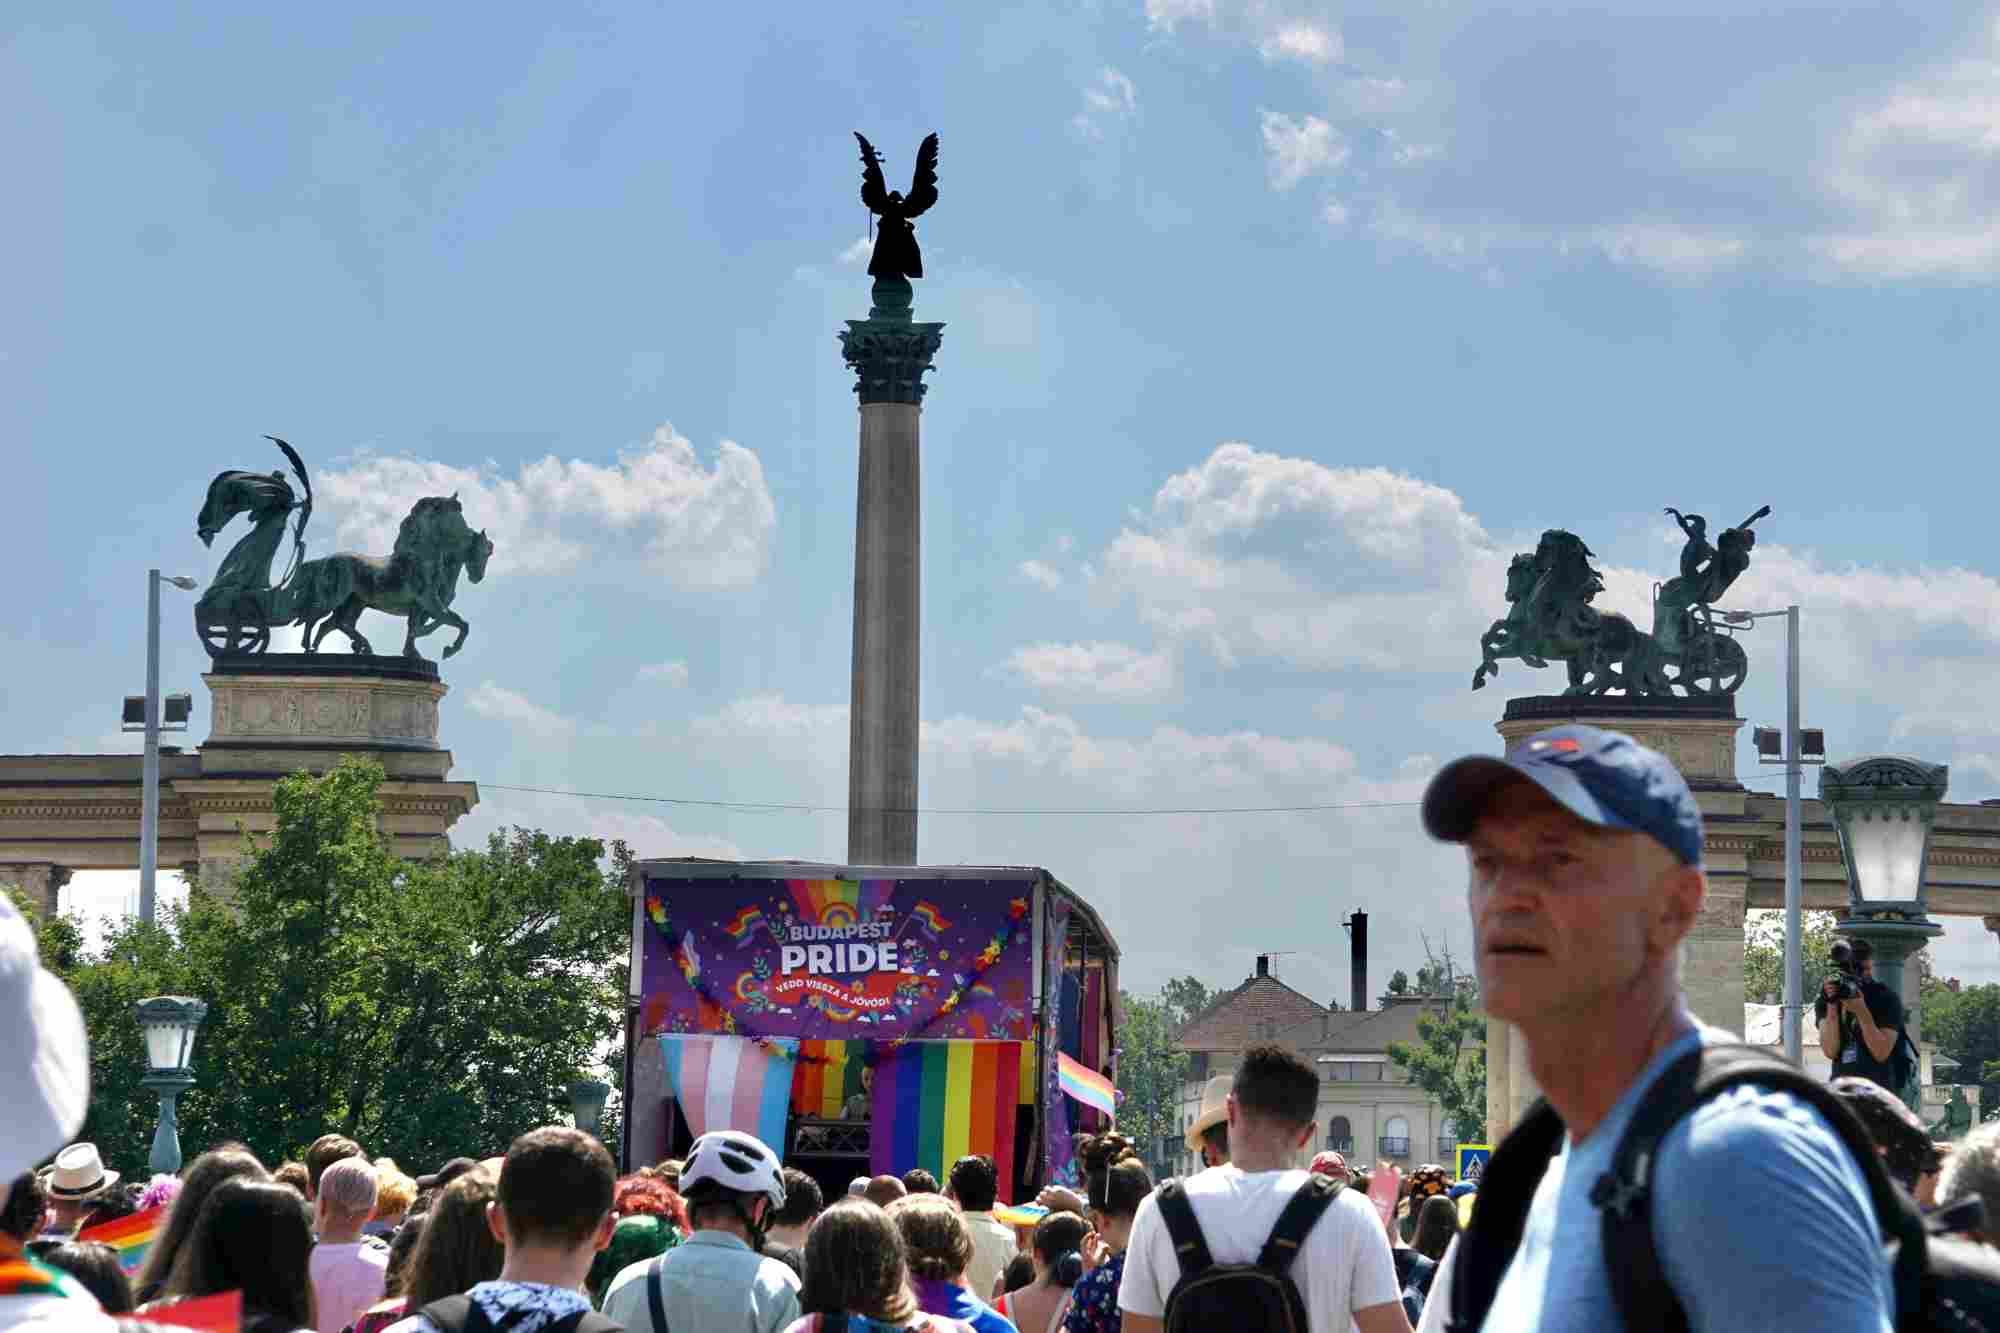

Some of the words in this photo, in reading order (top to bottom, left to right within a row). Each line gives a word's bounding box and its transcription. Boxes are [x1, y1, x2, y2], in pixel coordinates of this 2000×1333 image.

[791, 922, 892, 941] BUDAPEST
[781, 943, 898, 975] PRIDE
[775, 979, 804, 993] VEDD
[806, 979, 840, 998] VISSZA
